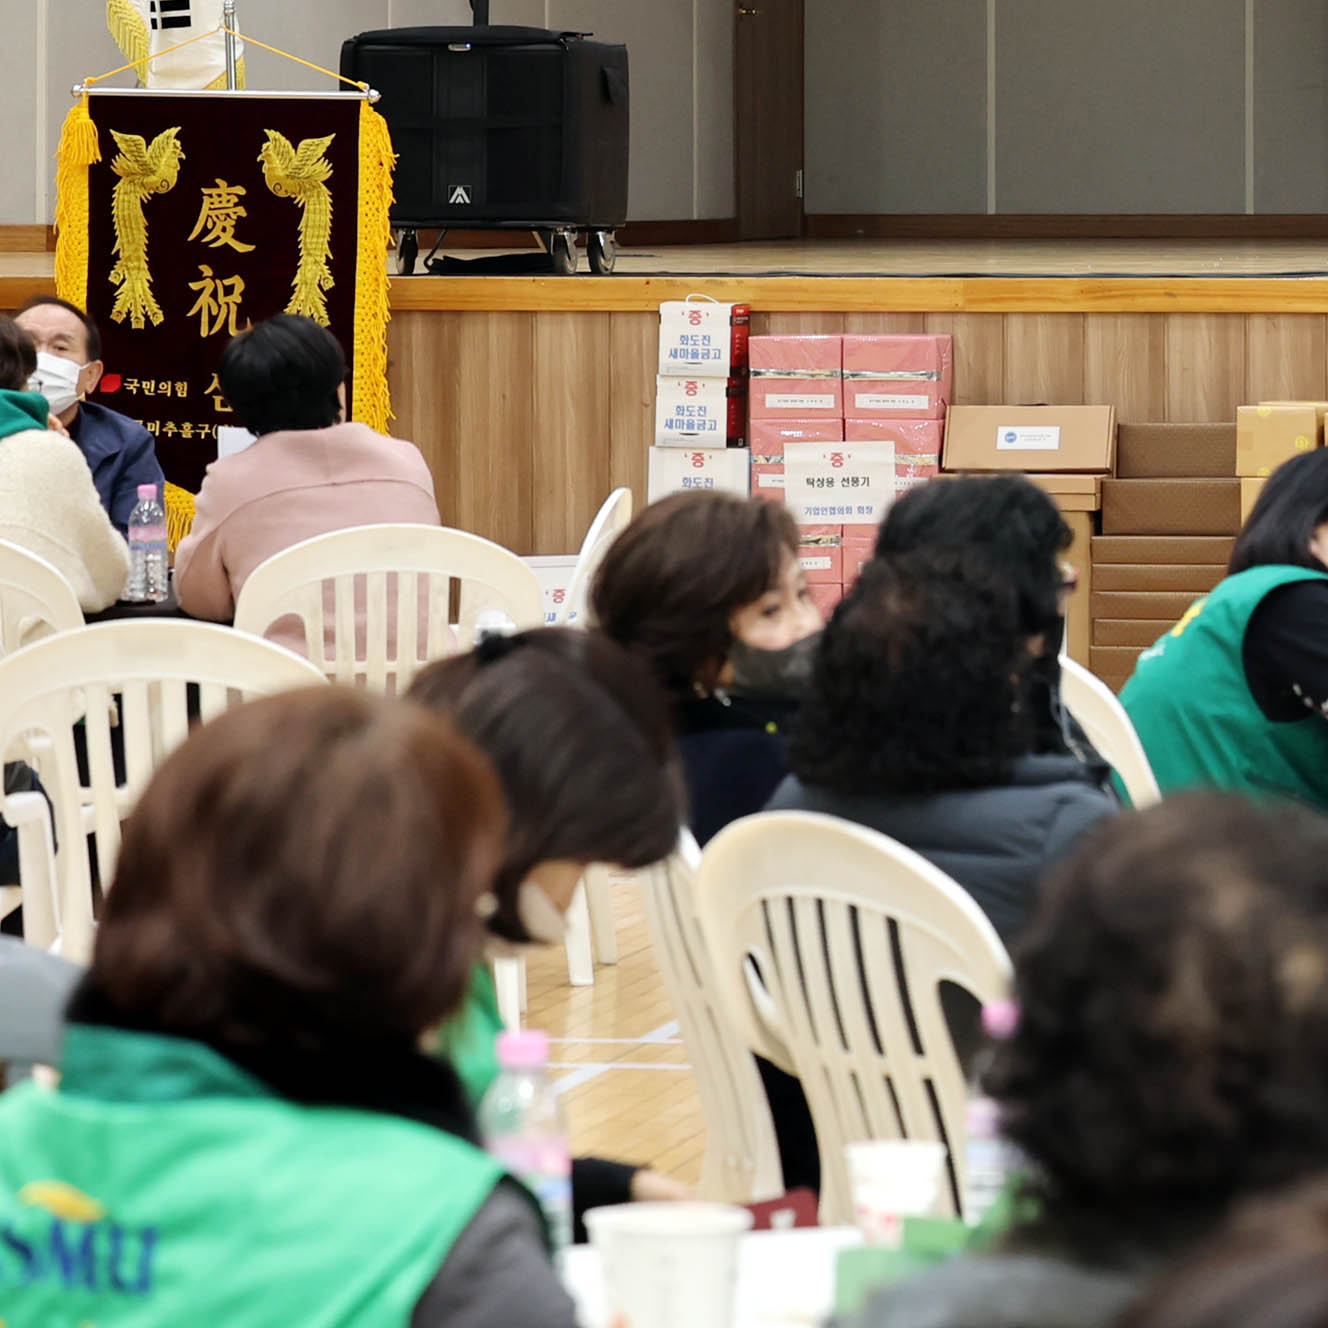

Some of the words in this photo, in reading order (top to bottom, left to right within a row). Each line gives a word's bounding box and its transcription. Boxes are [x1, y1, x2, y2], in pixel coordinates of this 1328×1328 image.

[187, 178, 256, 339] 慶祝
[680, 334, 711, 346] 화도진
[668, 348, 721, 360] 새마을금고
[124, 378, 188, 398] 국민의힘
[675, 405, 707, 417] 화도진
[664, 418, 717, 431] 새마을금고
[682, 476, 714, 489] 화도진
